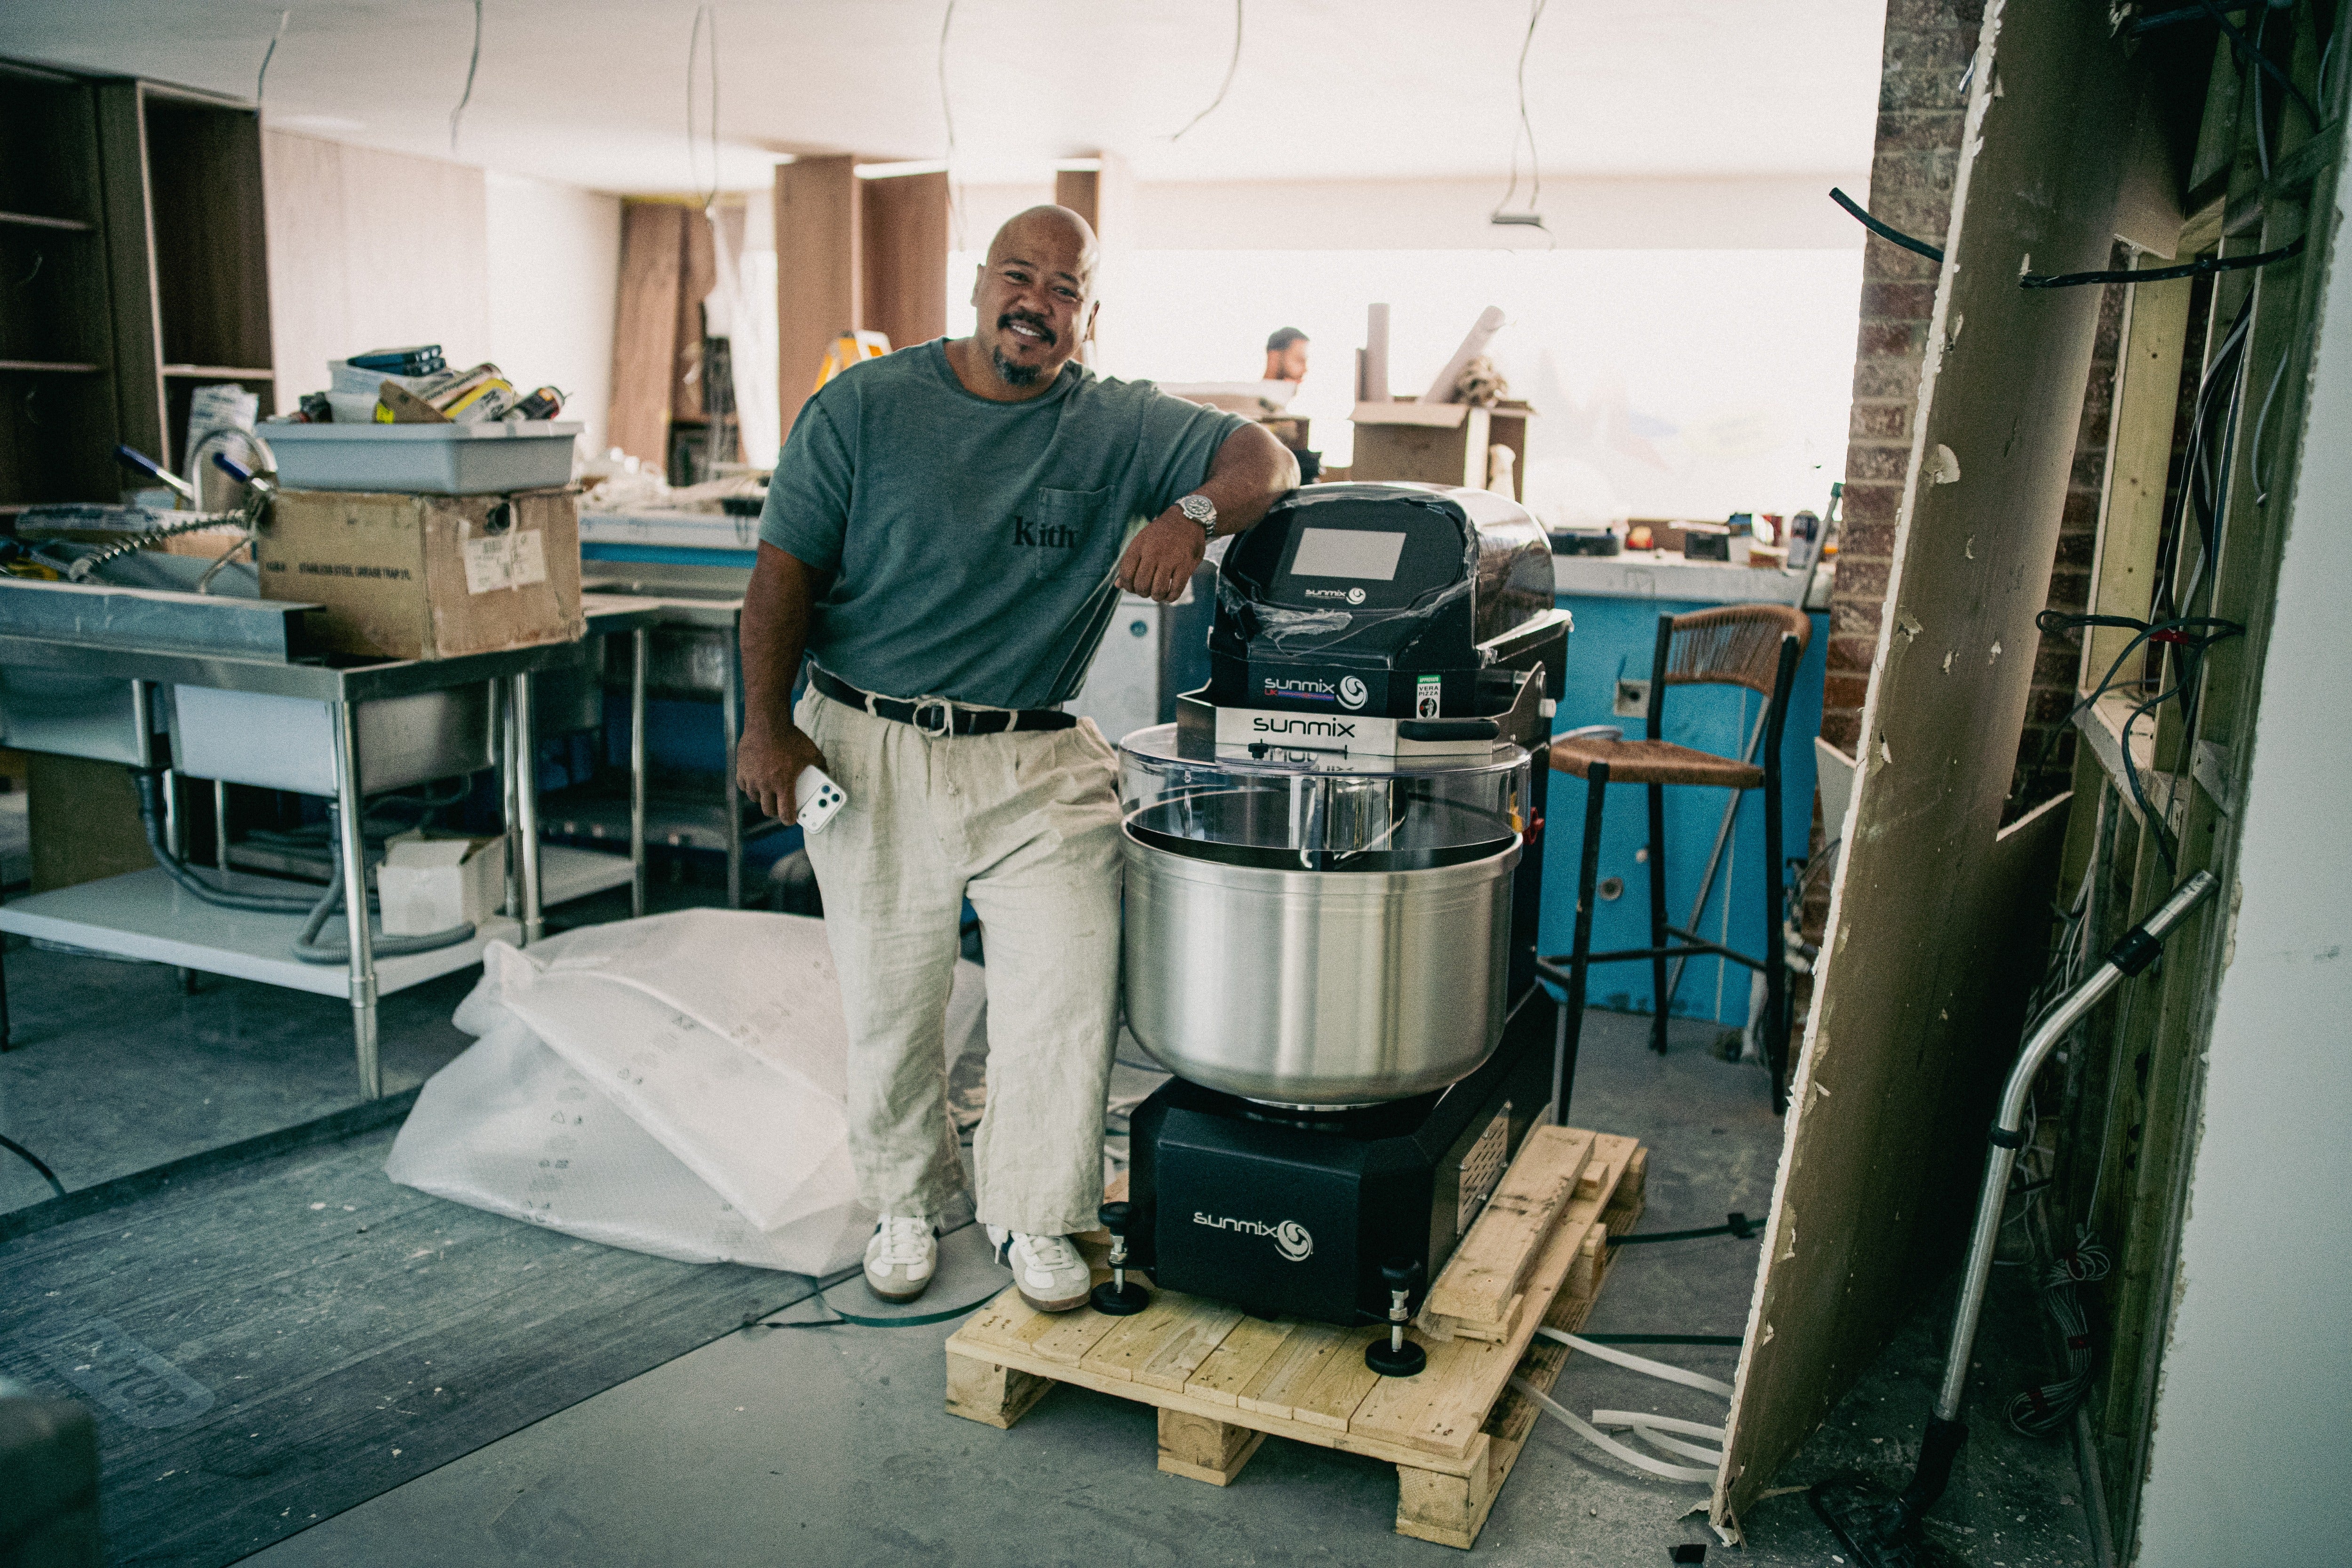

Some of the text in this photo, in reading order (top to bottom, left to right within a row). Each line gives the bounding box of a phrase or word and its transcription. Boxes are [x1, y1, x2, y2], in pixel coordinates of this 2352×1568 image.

[1012, 515, 1078, 549] Kith
[1264, 678, 1335, 693] sunmix
[1253, 717, 1356, 738] sunmix
[1193, 1212, 1278, 1238] sunmix
